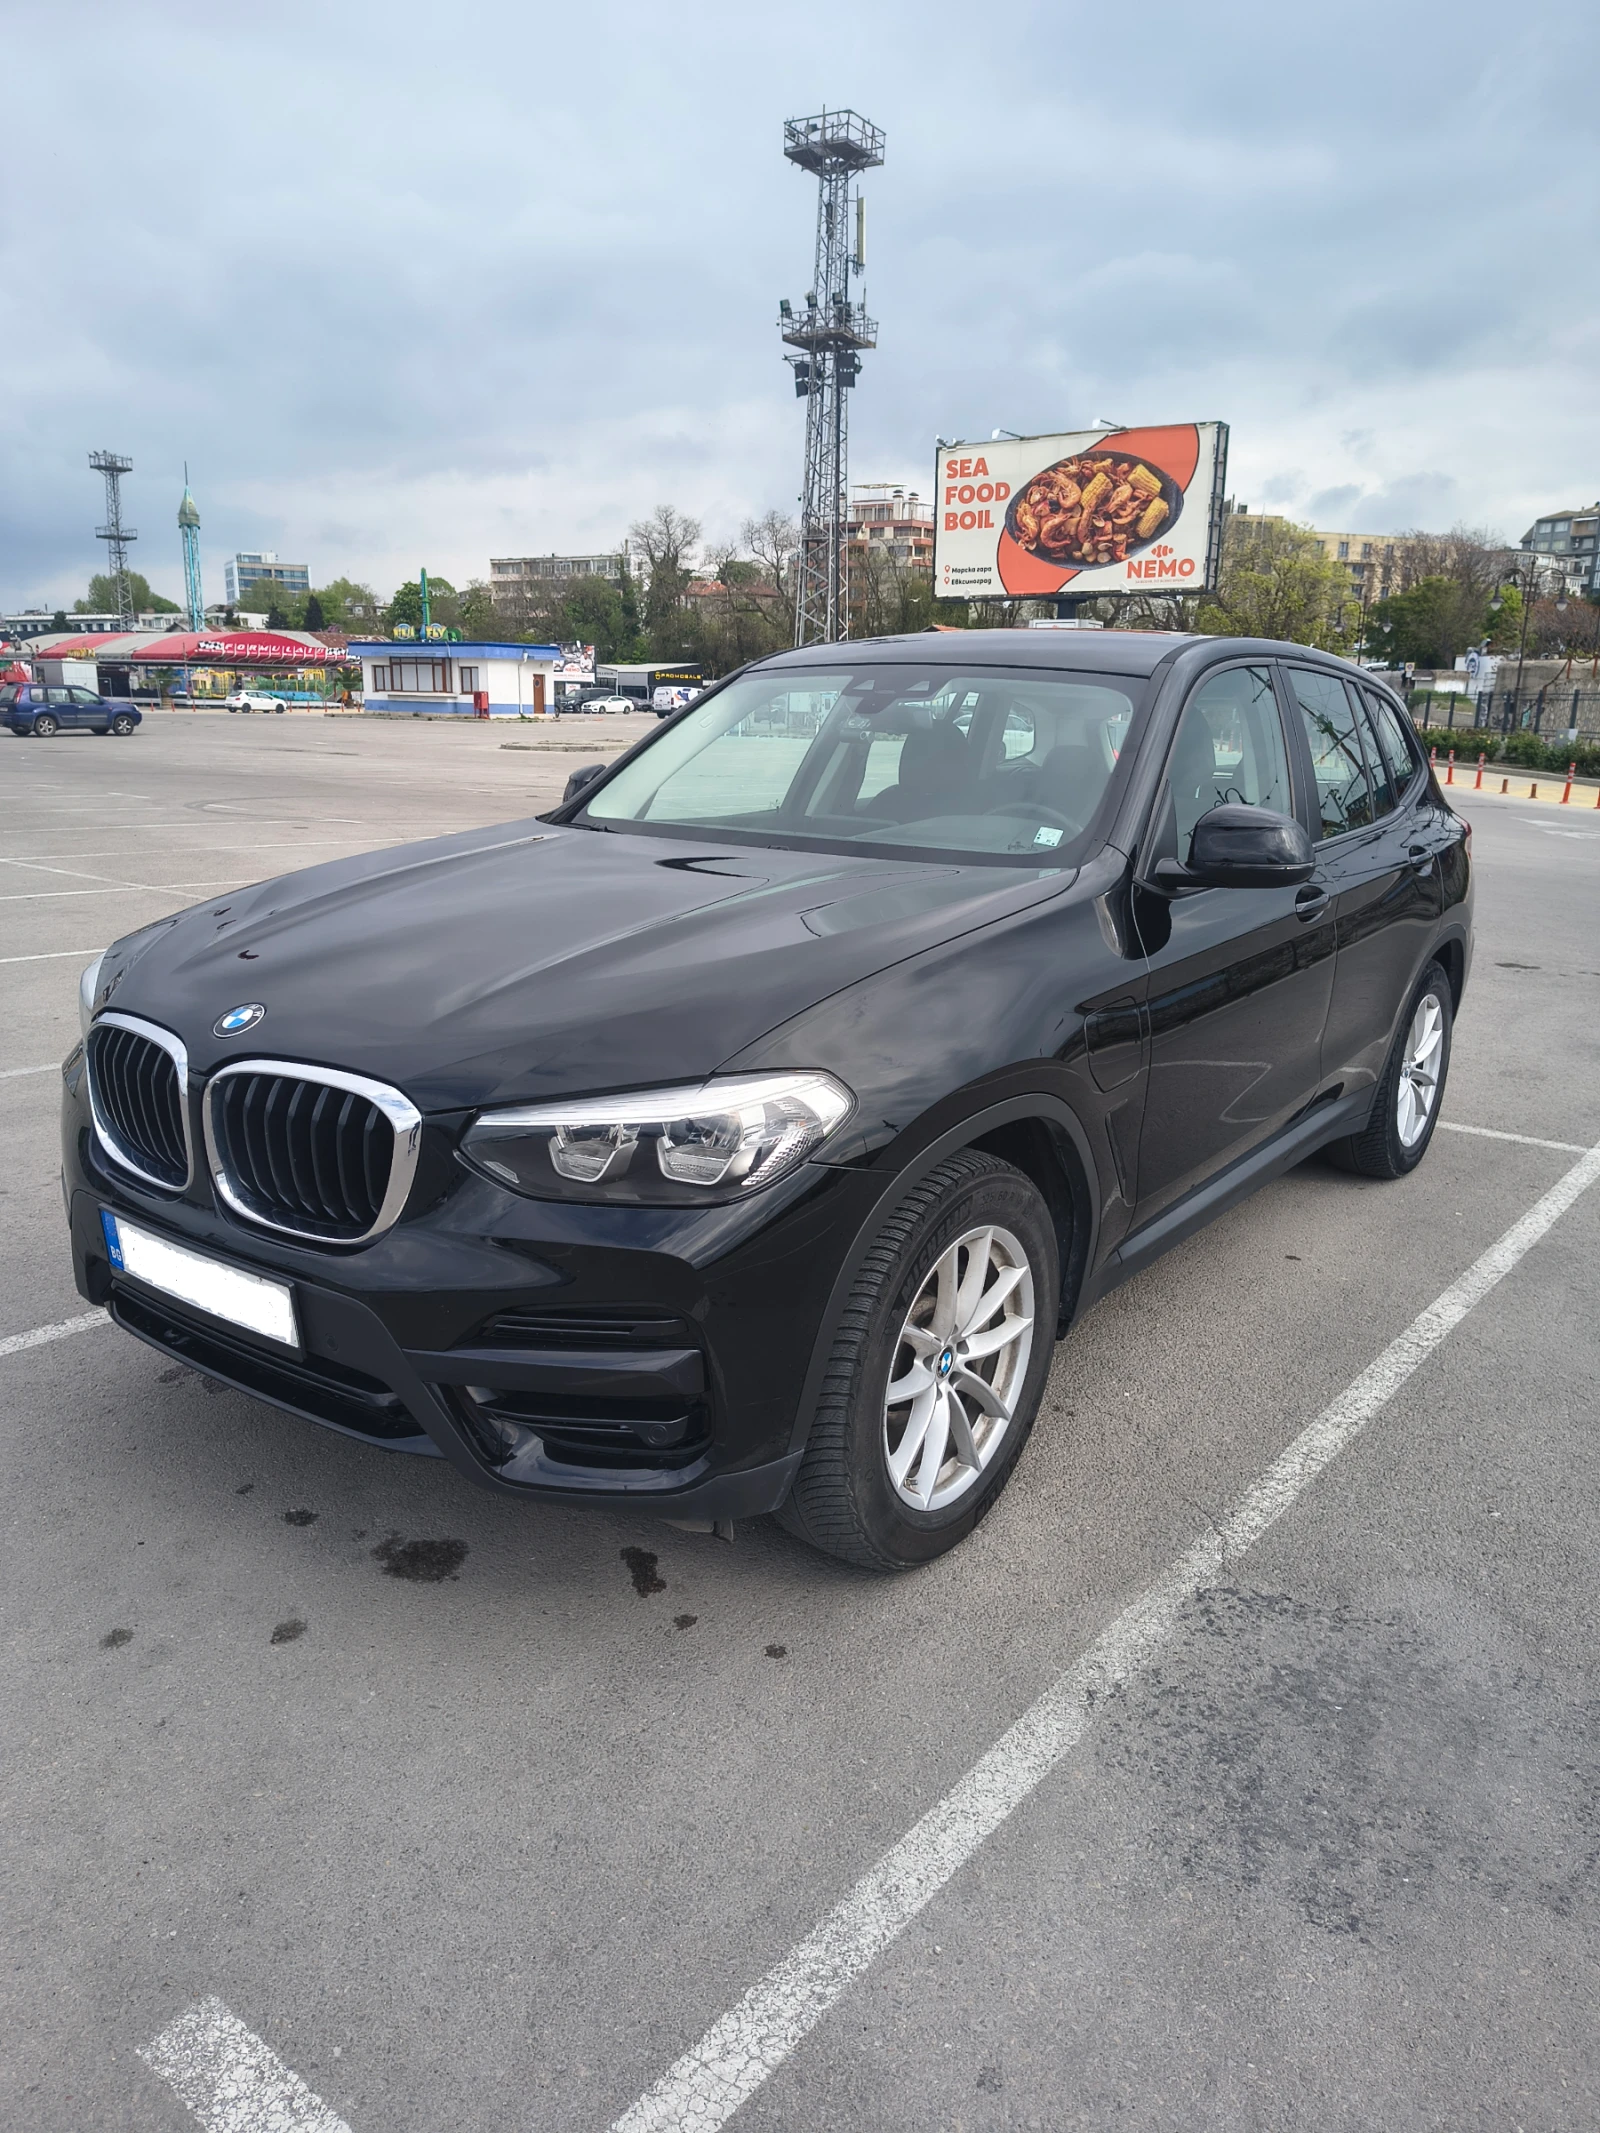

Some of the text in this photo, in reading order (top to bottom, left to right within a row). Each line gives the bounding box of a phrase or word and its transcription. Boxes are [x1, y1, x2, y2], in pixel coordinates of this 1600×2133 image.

[946, 457, 989, 479] SEA
[945, 482, 1011, 505] FOOD
[944, 509, 995, 531] BOIL
[1127, 558, 1196, 579] NEMO
[224, 643, 304, 653] FORMULA
[110, 1245, 122, 1261] BG
